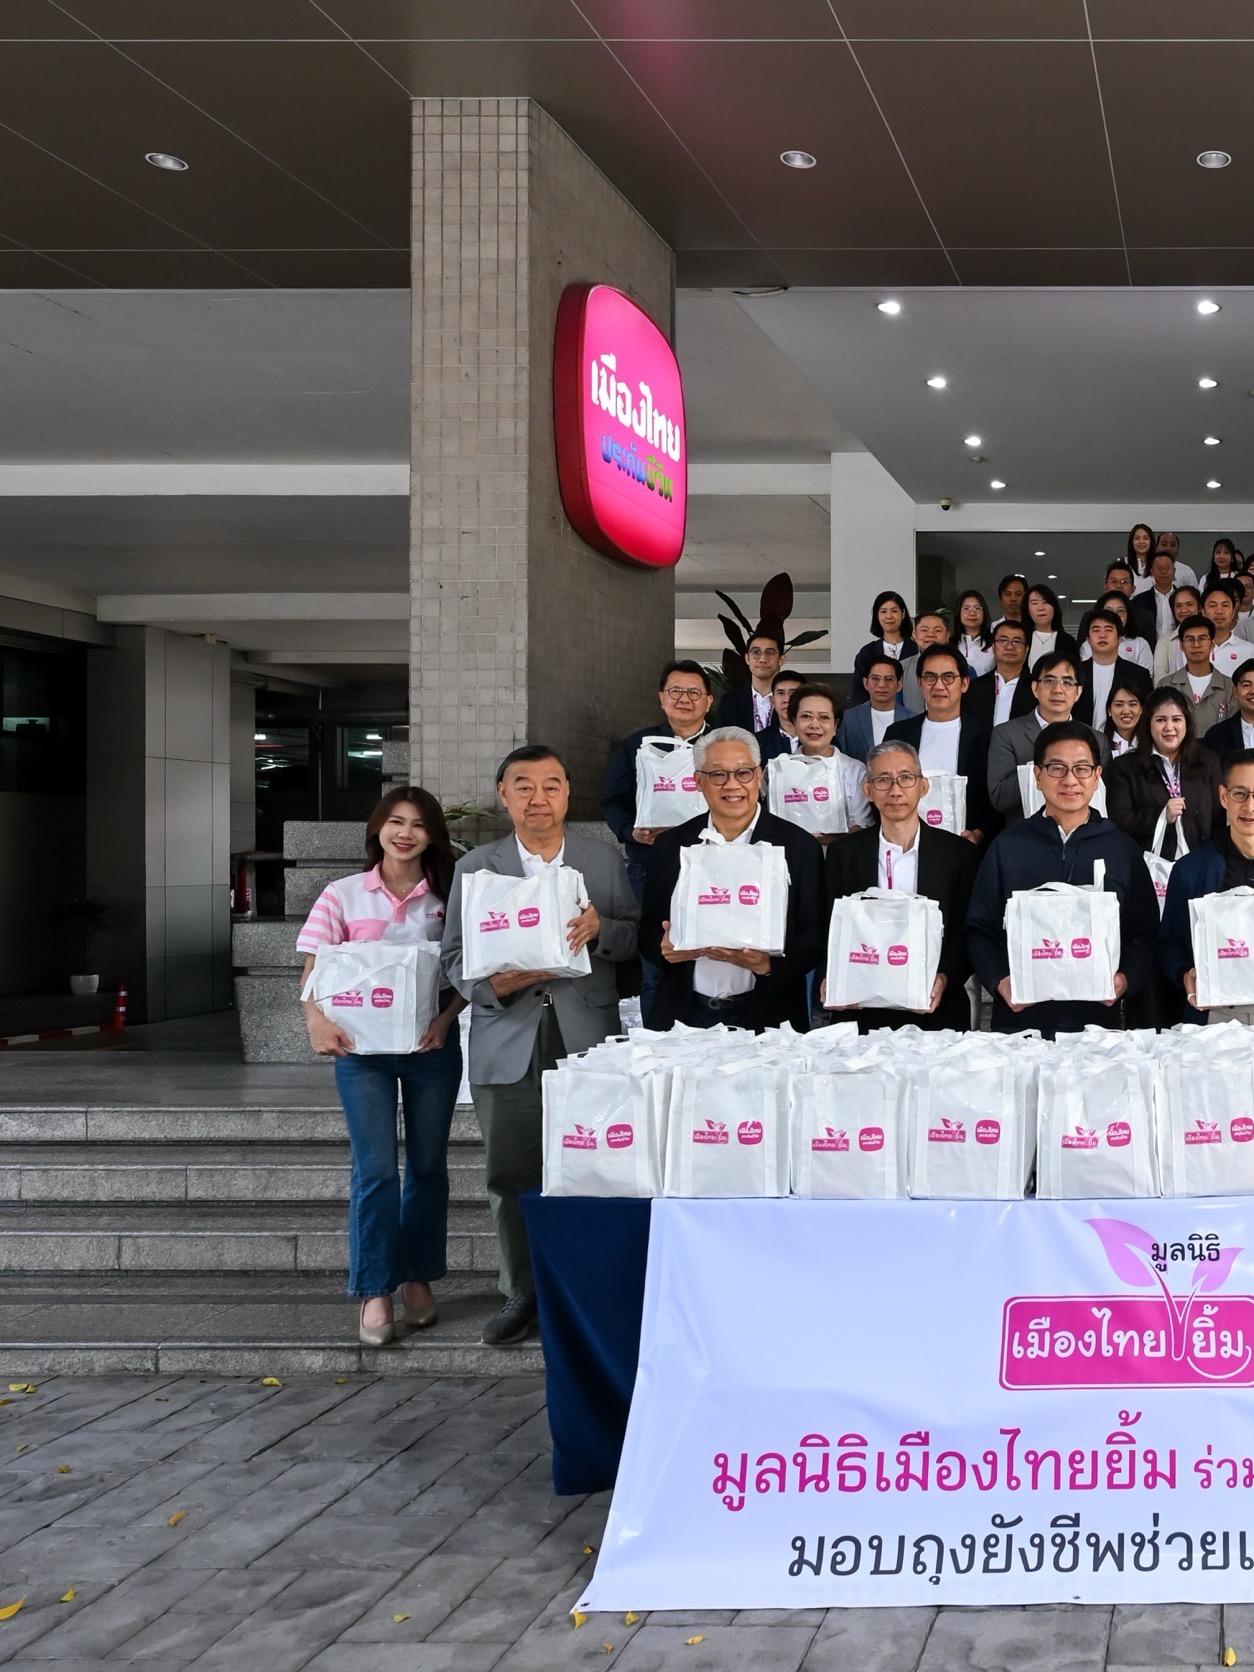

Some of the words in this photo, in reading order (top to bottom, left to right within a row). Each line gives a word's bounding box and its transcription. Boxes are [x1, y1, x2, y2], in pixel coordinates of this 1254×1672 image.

[591, 352, 681, 463] เมืองไทย
[1151, 1233, 1221, 1272] มูลนิธิ
[1012, 1307, 1166, 1359] เมืองไทย
[1192, 1304, 1243, 1359] ยิ้ม
[712, 1410, 1177, 1511] มูลนิธิเมืองไทยยิ้ม
